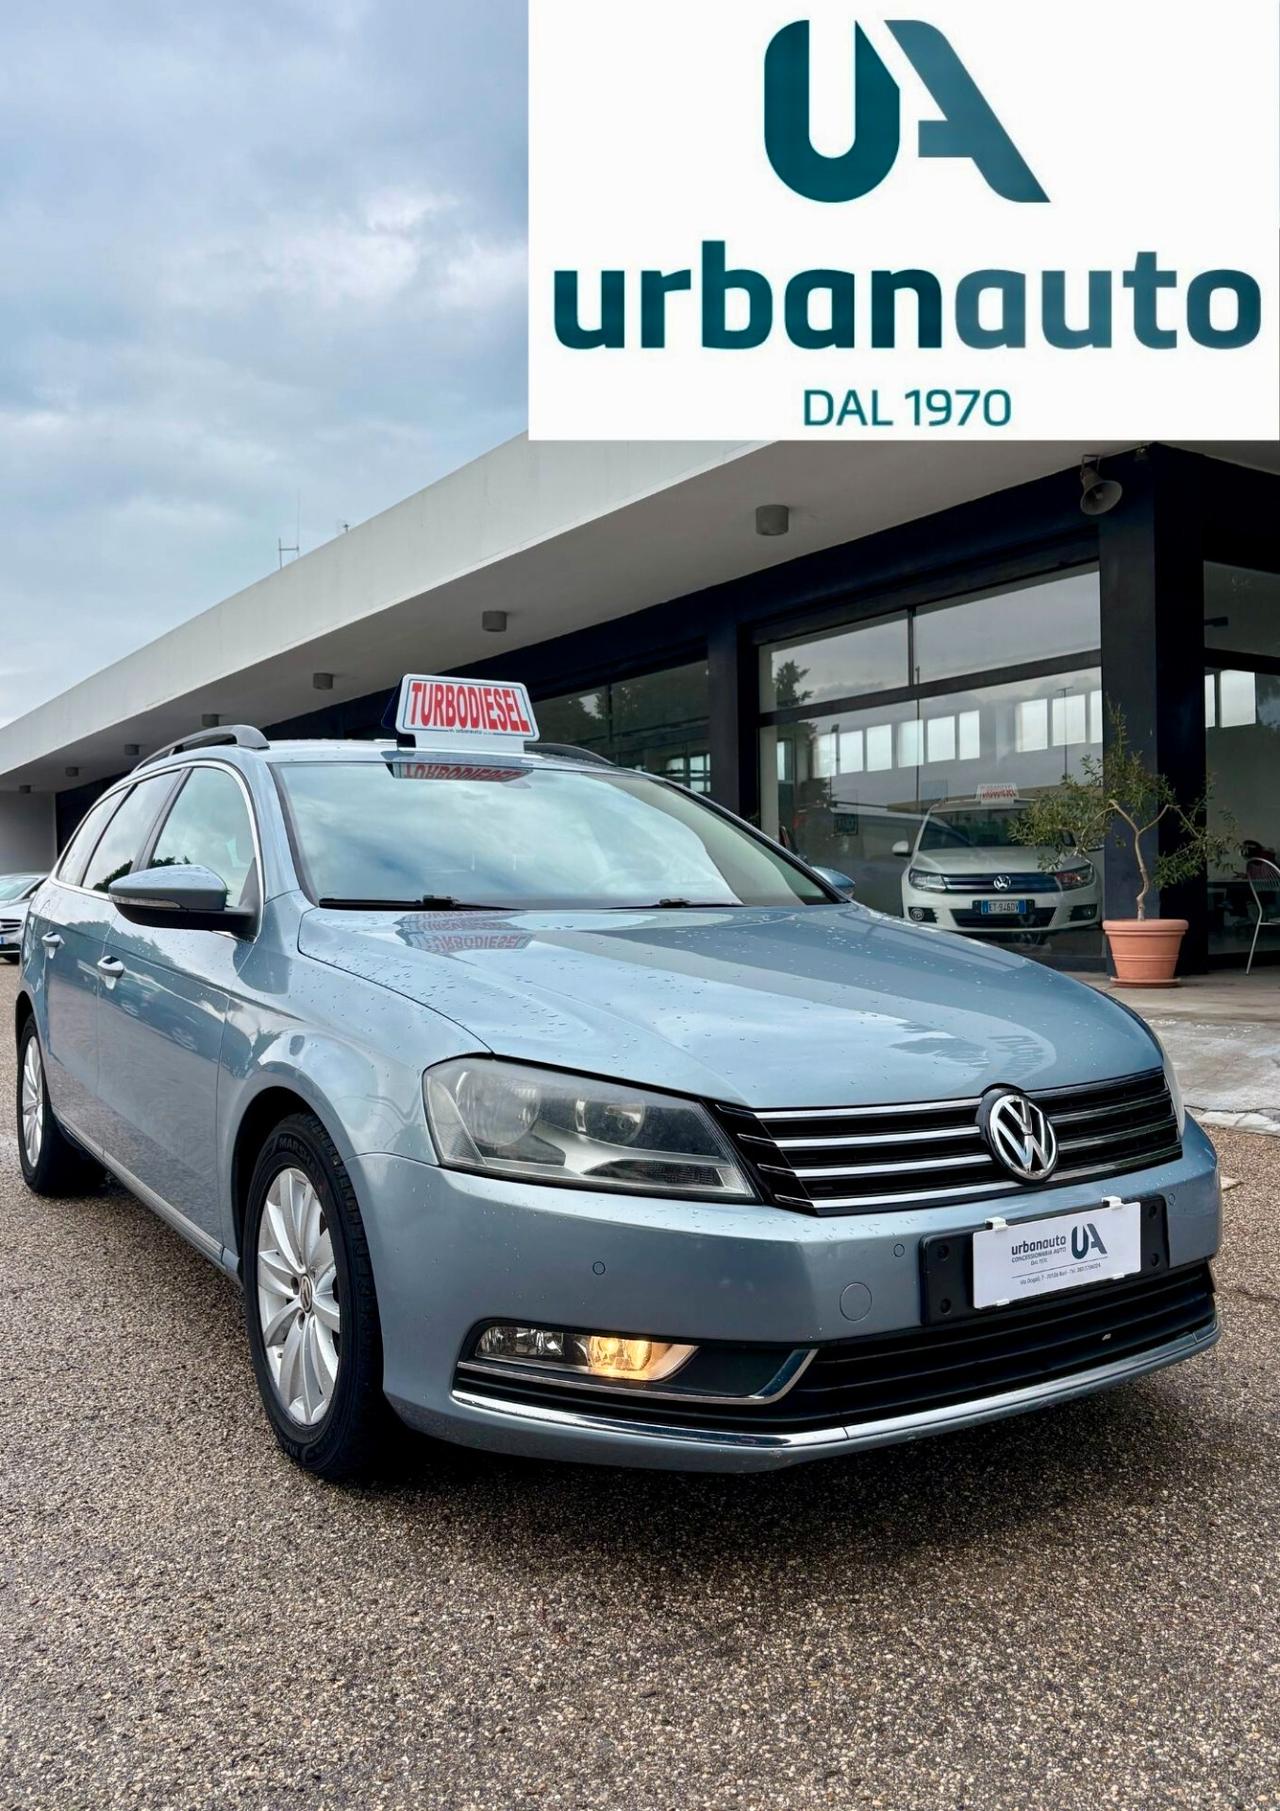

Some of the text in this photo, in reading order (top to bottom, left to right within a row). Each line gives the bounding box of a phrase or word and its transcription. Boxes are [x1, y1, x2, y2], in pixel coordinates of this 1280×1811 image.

[410, 682, 531, 733] TURBODIESEL
[1011, 1222, 1108, 1260] urbanauto UA
